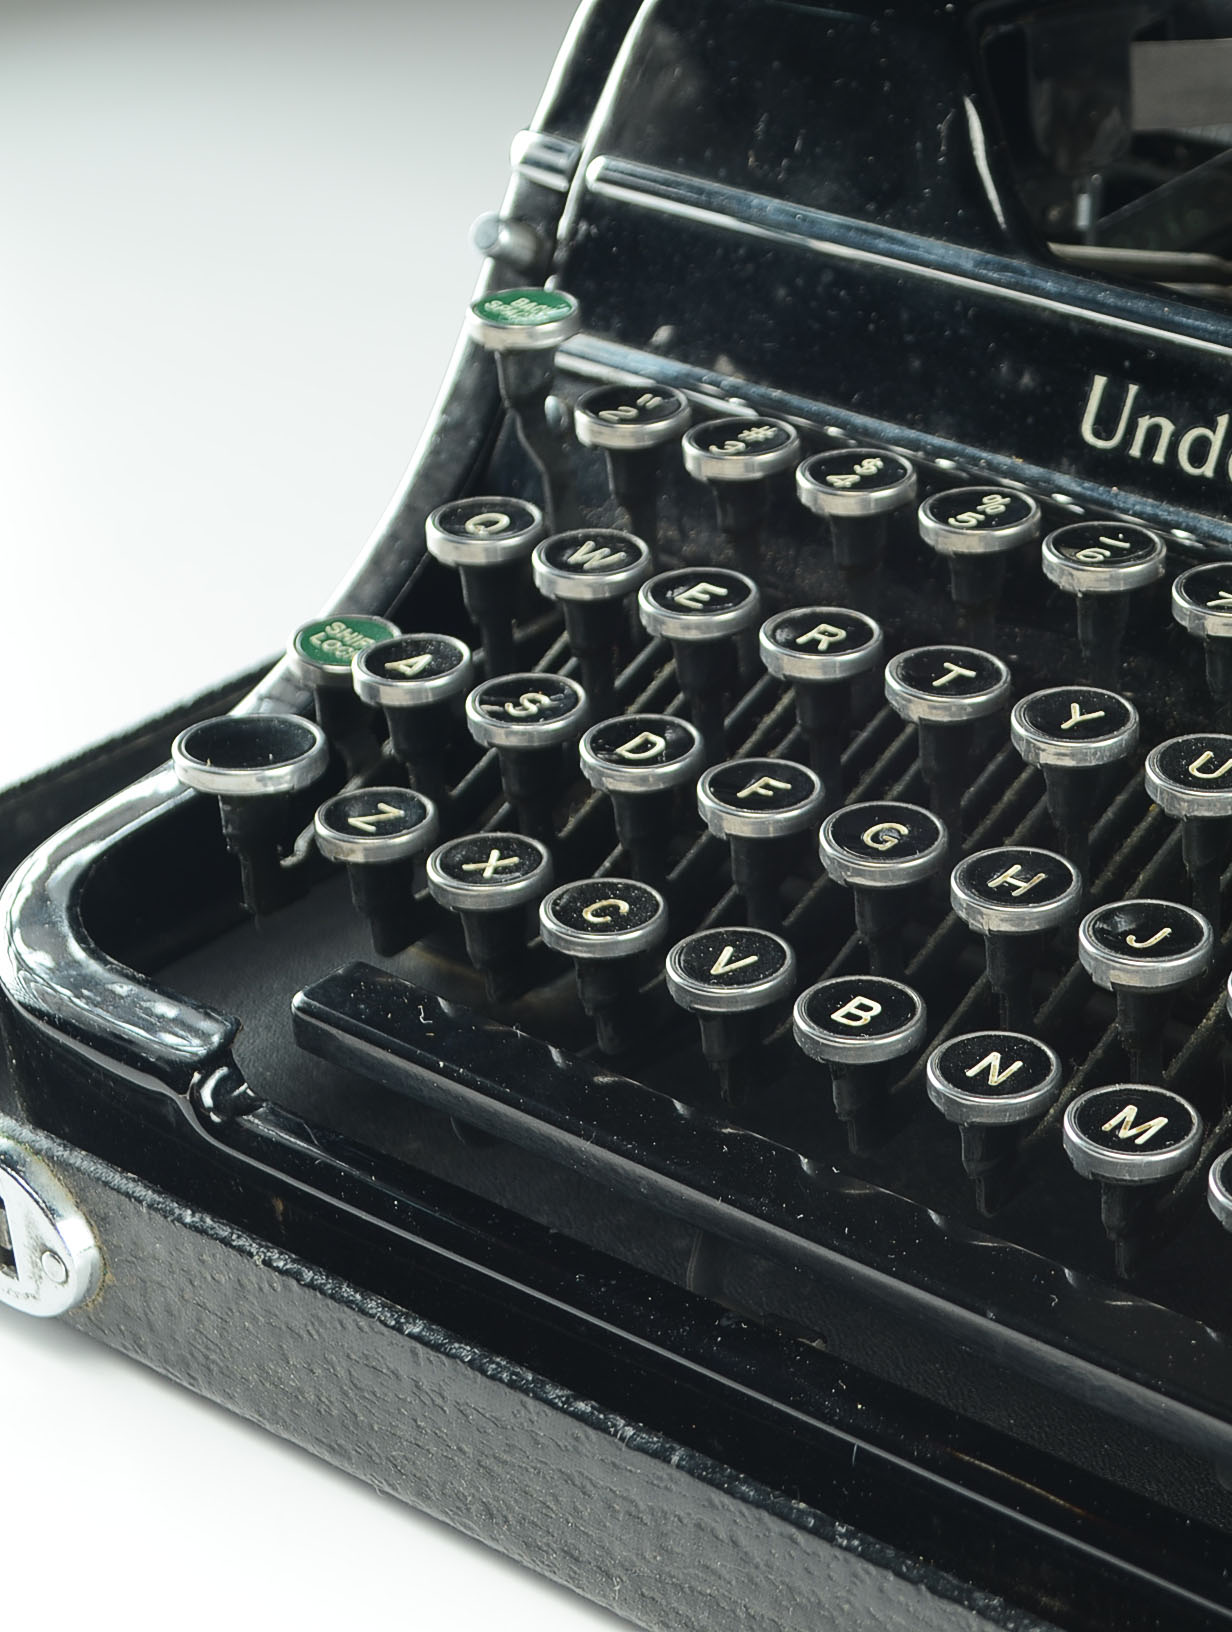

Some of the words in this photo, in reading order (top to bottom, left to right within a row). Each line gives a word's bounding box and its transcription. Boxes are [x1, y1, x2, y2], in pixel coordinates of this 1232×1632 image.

[464, 512, 511, 537] Q
[567, 540, 627, 570] W
[672, 582, 728, 609] E
[309, 631, 358, 658] LOC
[324, 621, 377, 649] SHIF
[795, 623, 847, 651] R
[384, 653, 433, 675] A
[932, 662, 977, 687] T
[504, 692, 554, 717] S
[1060, 702, 1105, 729] Y
[614, 731, 666, 759] D
[736, 776, 792, 798] F
[347, 802, 405, 832] Z
[862, 822, 909, 851] G
[461, 849, 520, 879] X
[986, 864, 1046, 897] H
[582, 898, 630, 924] C
[1125, 927, 1172, 948] J
[710, 945, 759, 975] V
[830, 995, 882, 1027] B
[964, 1051, 1024, 1086] N
[1101, 1104, 1169, 1145] M
